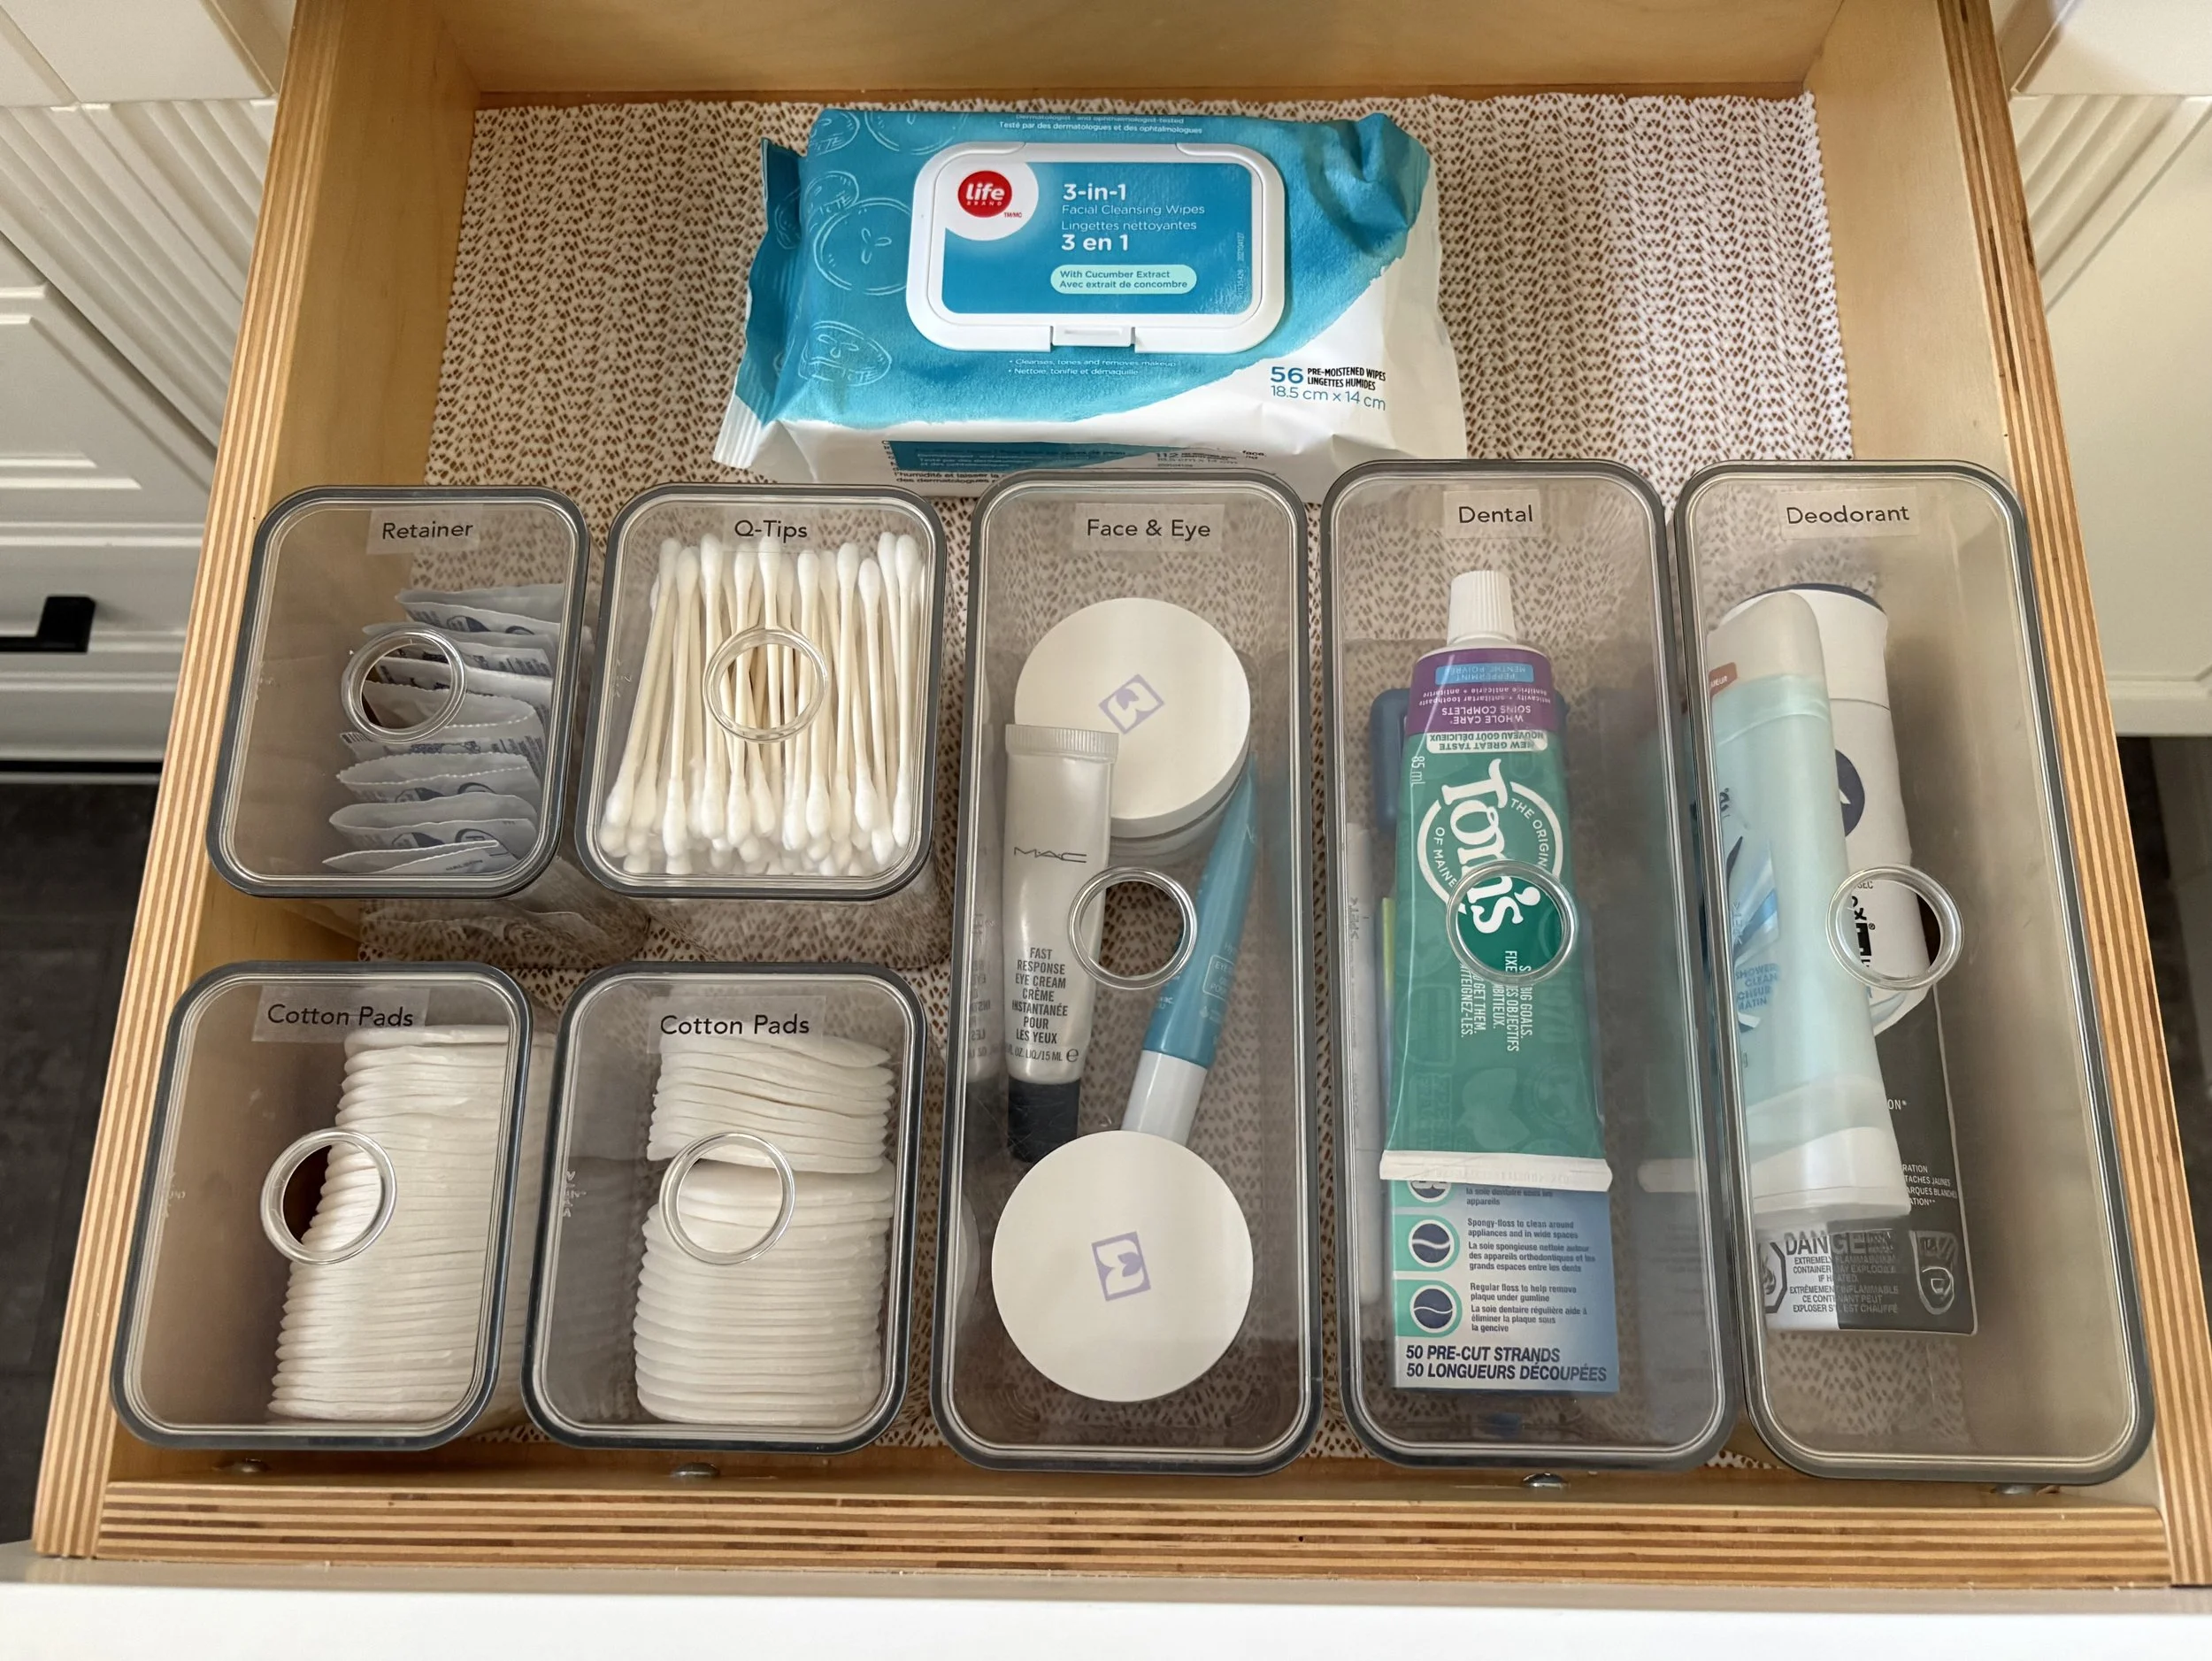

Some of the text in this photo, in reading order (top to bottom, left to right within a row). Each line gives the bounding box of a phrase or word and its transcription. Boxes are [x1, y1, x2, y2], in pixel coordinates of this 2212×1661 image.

[999, 120, 1020, 129] Testé
[1053, 122, 1111, 132] dermatologues
[1140, 124, 1203, 135] ophtalmologues
[965, 183, 1005, 202] life
[1063, 182, 1127, 201] 3-in-1
[1062, 204, 1205, 217] Facial Cleansing Wipes
[1061, 220, 1197, 233] Lingettes nettoyantes
[1061, 234, 1129, 251] 3 en 1
[1060, 270, 1171, 279] With Cucumber Extract
[1059, 280, 1188, 288] Avec extrait de concombre
[1091, 367, 1139, 377] démaquille
[1271, 365, 1386, 384] 56 PRE-MOISTENED WIPES
[1307, 376, 1376, 391] LINGETTES HUMIDES
[1271, 385, 1386, 411] 18.5 cm x 14 cm
[1457, 504, 1534, 525] Dental
[1786, 504, 1911, 526] Deodorant
[381, 519, 474, 542] Retainer
[733, 519, 809, 542] Q-Tips
[1087, 518, 1212, 542] Face & Eye
[1441, 705, 1532, 716] SOINS COMPLETS
[1485, 715, 1525, 724] WHOLE
[1429, 733, 1473, 742] DÉLICIEUX
[1499, 731, 1545, 740] NOUVEAU
[1439, 742, 1470, 751] TASTE
[1473, 742, 1508, 750] GREAT
[1410, 756, 1425, 769] 85
[1509, 798, 1551, 869] THE ORIGIN
[1440, 757, 1541, 934] Tom's
[1432, 827, 1457, 888] OF MAINE
[1029, 947, 1053, 961] FAST
[1017, 959, 1066, 975] RESPONSE
[1015, 973, 1067, 989] EYE CREAM
[1744, 973, 1778, 988] CLEAN
[1022, 987, 1055, 1003] CRÈME
[1519, 987, 1533, 1001] BIG
[266, 1003, 414, 1027] Cotton Pads
[1011, 1000, 1069, 1017] INSTANTANÉE
[1473, 982, 1486, 1034] GET THEM.
[660, 1013, 810, 1037] Cotton Pads
[1023, 1015, 1049, 1030] POUR
[1506, 999, 1520, 1052] OBJECTIFS
[1519, 1003, 1533, 1039] GOALS.
[1016, 1028, 1058, 1045] LES YEUX
[1051, 1050, 1064, 1062] ML
[1932, 1177, 1951, 1188] JAUNES
[1466, 1197, 1501, 1206] appareils
[1467, 1218, 1516, 1228] Spongy-floss
[1526, 1219, 1547, 1228] clean
[1548, 1220, 1574, 1229] around
[1468, 1228, 1508, 1238] appliances
[1552, 1231, 1578, 1240] spaces
[1468, 1241, 1538, 1252] La soie spongieuse
[1783, 1229, 1883, 1256] DANGE
[1484, 1252, 1517, 1262] appareils
[1518, 1253, 1575, 1263] orthodontiques
[1469, 1262, 1495, 1272] grands
[1496, 1263, 1527, 1272] espaces
[1548, 1263, 1561, 1272] les
[1561, 1264, 1582, 1273] dents
[1793, 1265, 1832, 1274] CONTAINER
[1817, 1274, 1825, 1283] IF
[1470, 1282, 1500, 1293] Regular
[1502, 1282, 1520, 1292] floss
[1530, 1284, 1548, 1294] help
[1470, 1292, 1550, 1303] plaque under gumline
[1801, 1295, 1812, 1303] CE
[1471, 1304, 1481, 1313] La
[1481, 1305, 1497, 1314] soie
[1499, 1305, 1529, 1314] dentaire
[1530, 1305, 1563, 1316] régulière
[1793, 1303, 1828, 1313] EXPLOSER
[1511, 1315, 1537, 1325] plaque
[1480, 1324, 1509, 1334] gencive
[1405, 1344, 1561, 1363] 50 PRE-CUT STRANDS
[1406, 1361, 1608, 1382] 50 LONGUEURS DÉCOUPÉES
